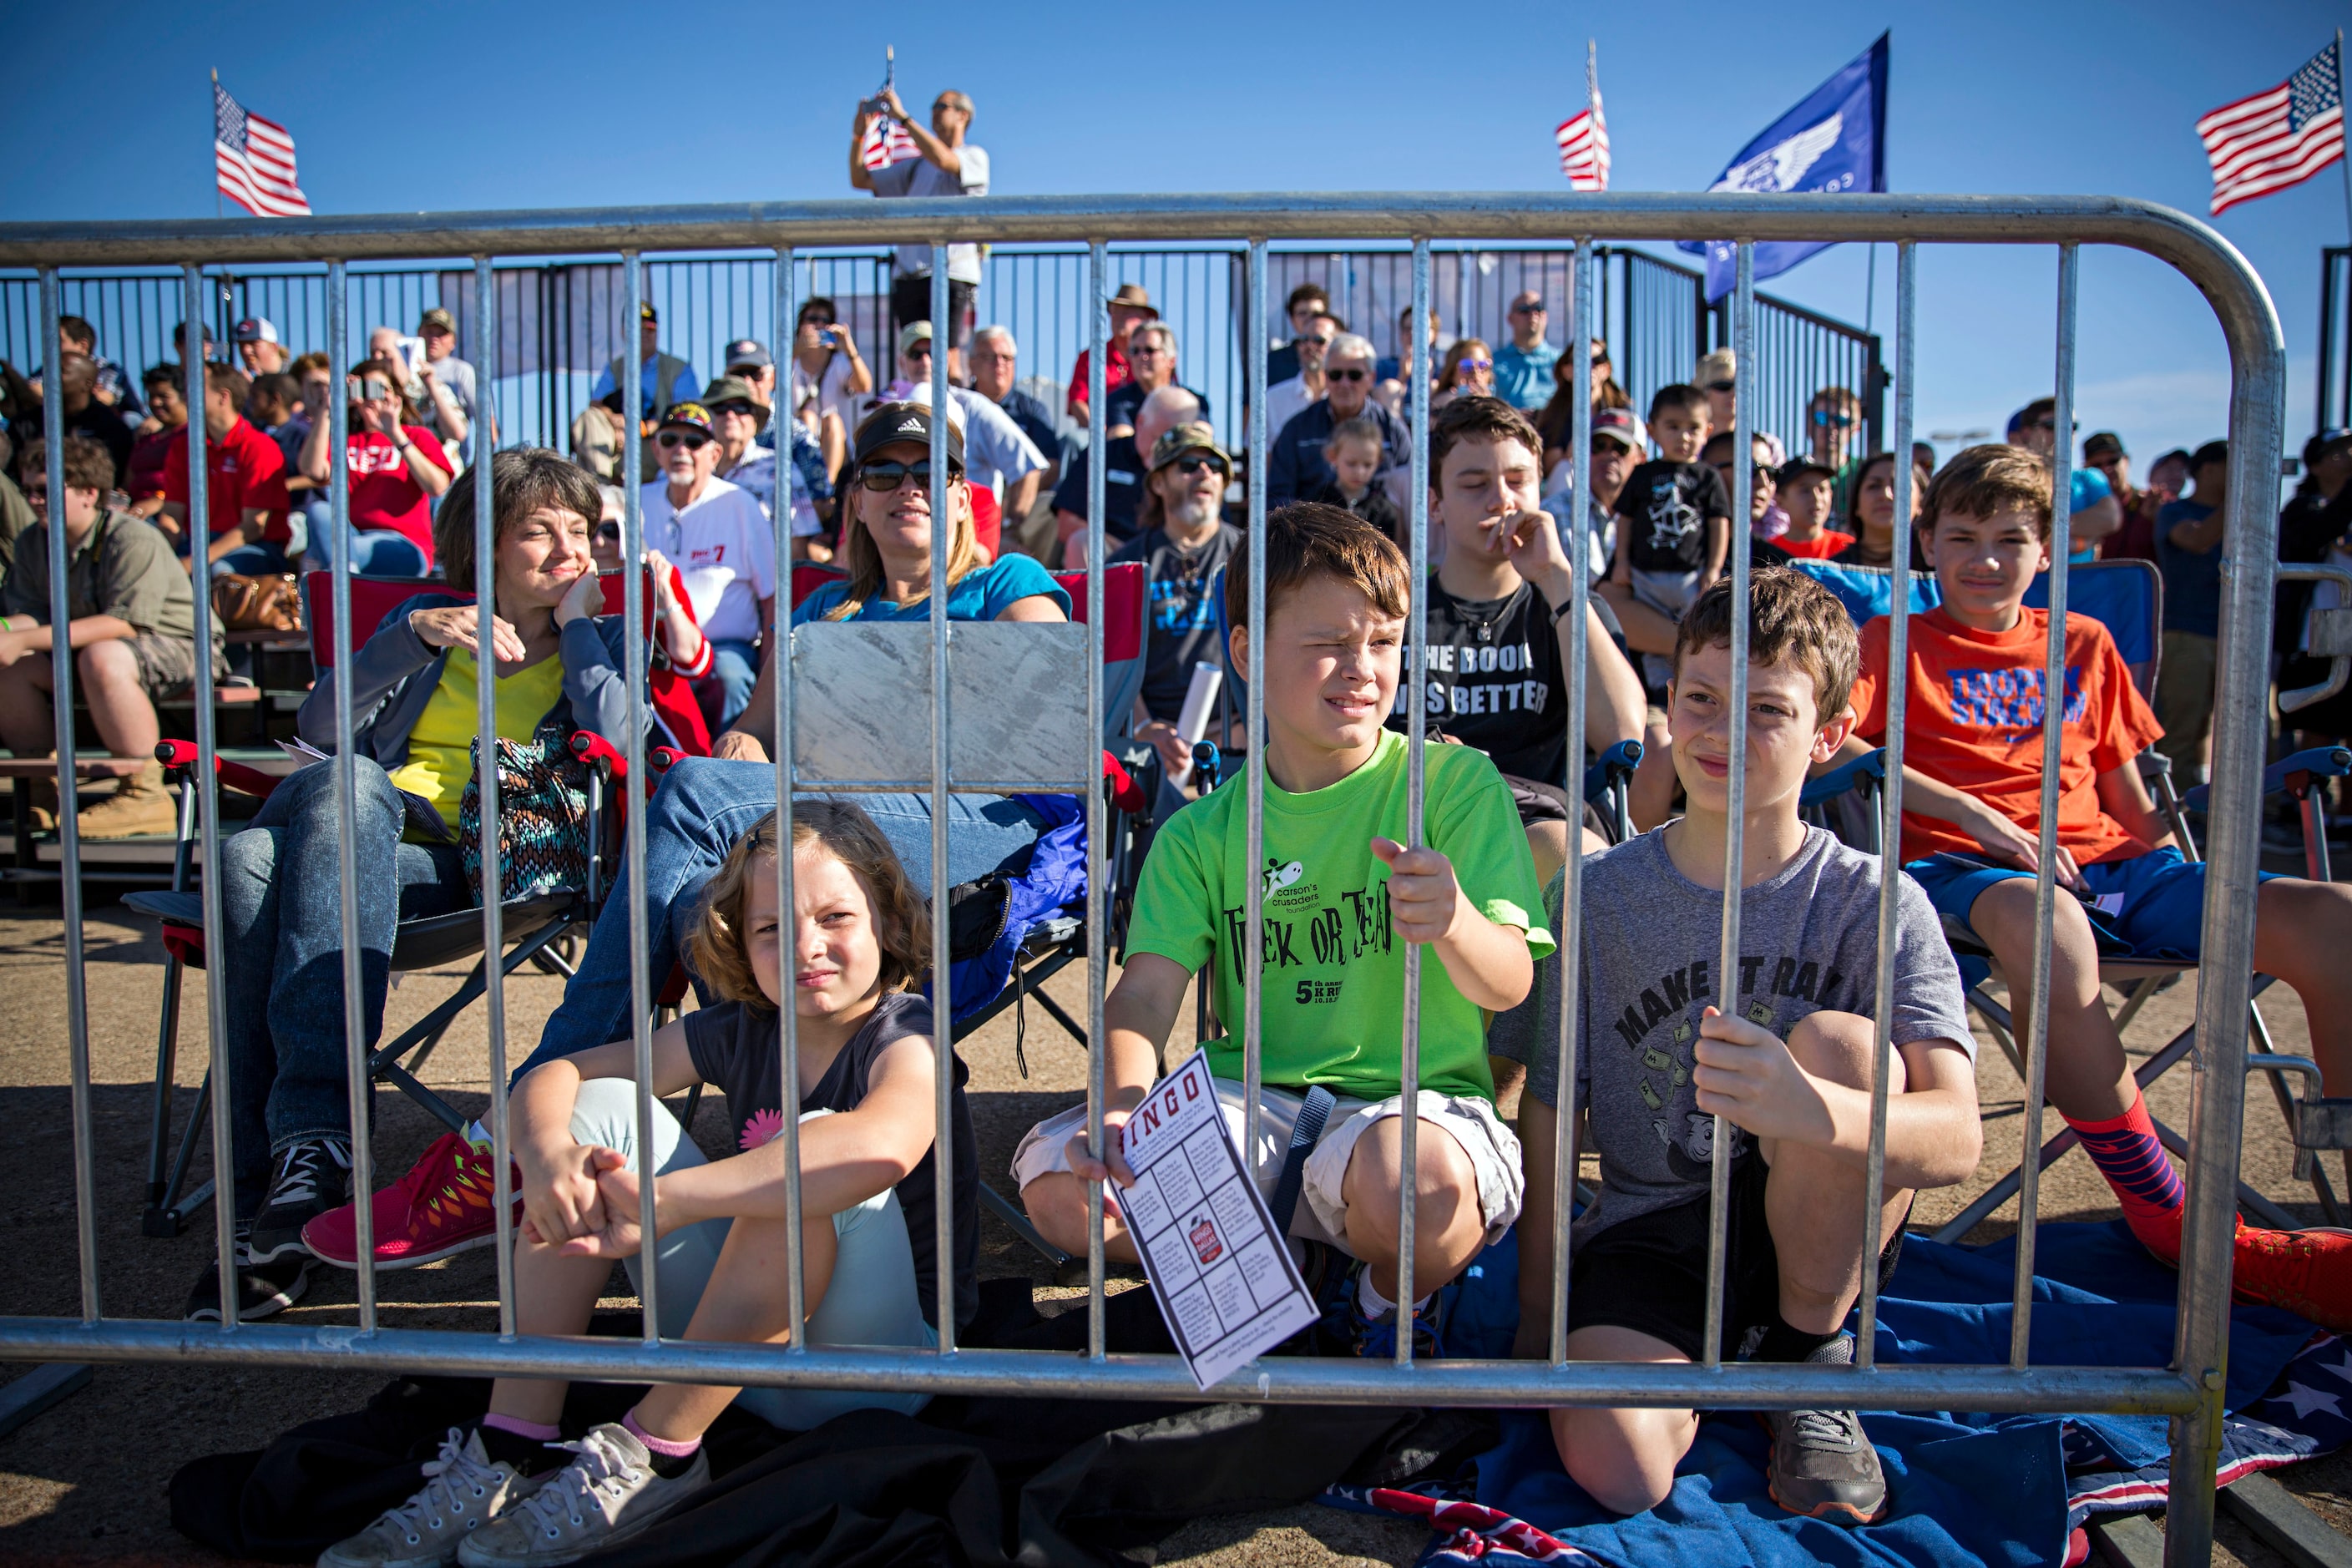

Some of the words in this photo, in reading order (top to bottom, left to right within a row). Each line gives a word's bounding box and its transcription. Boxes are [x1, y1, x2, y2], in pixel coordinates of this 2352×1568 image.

[898, 424, 926, 433] adidas
[1451, 680, 1549, 715] BETTER
[1277, 883, 1318, 897] carson's
[1272, 893, 1319, 907] crusaders
[1286, 902, 1320, 914] foundation
[1310, 908, 1347, 966] OR
[1614, 960, 1710, 1050] MAKE
[1196, 1235, 1216, 1252] DALLAS
